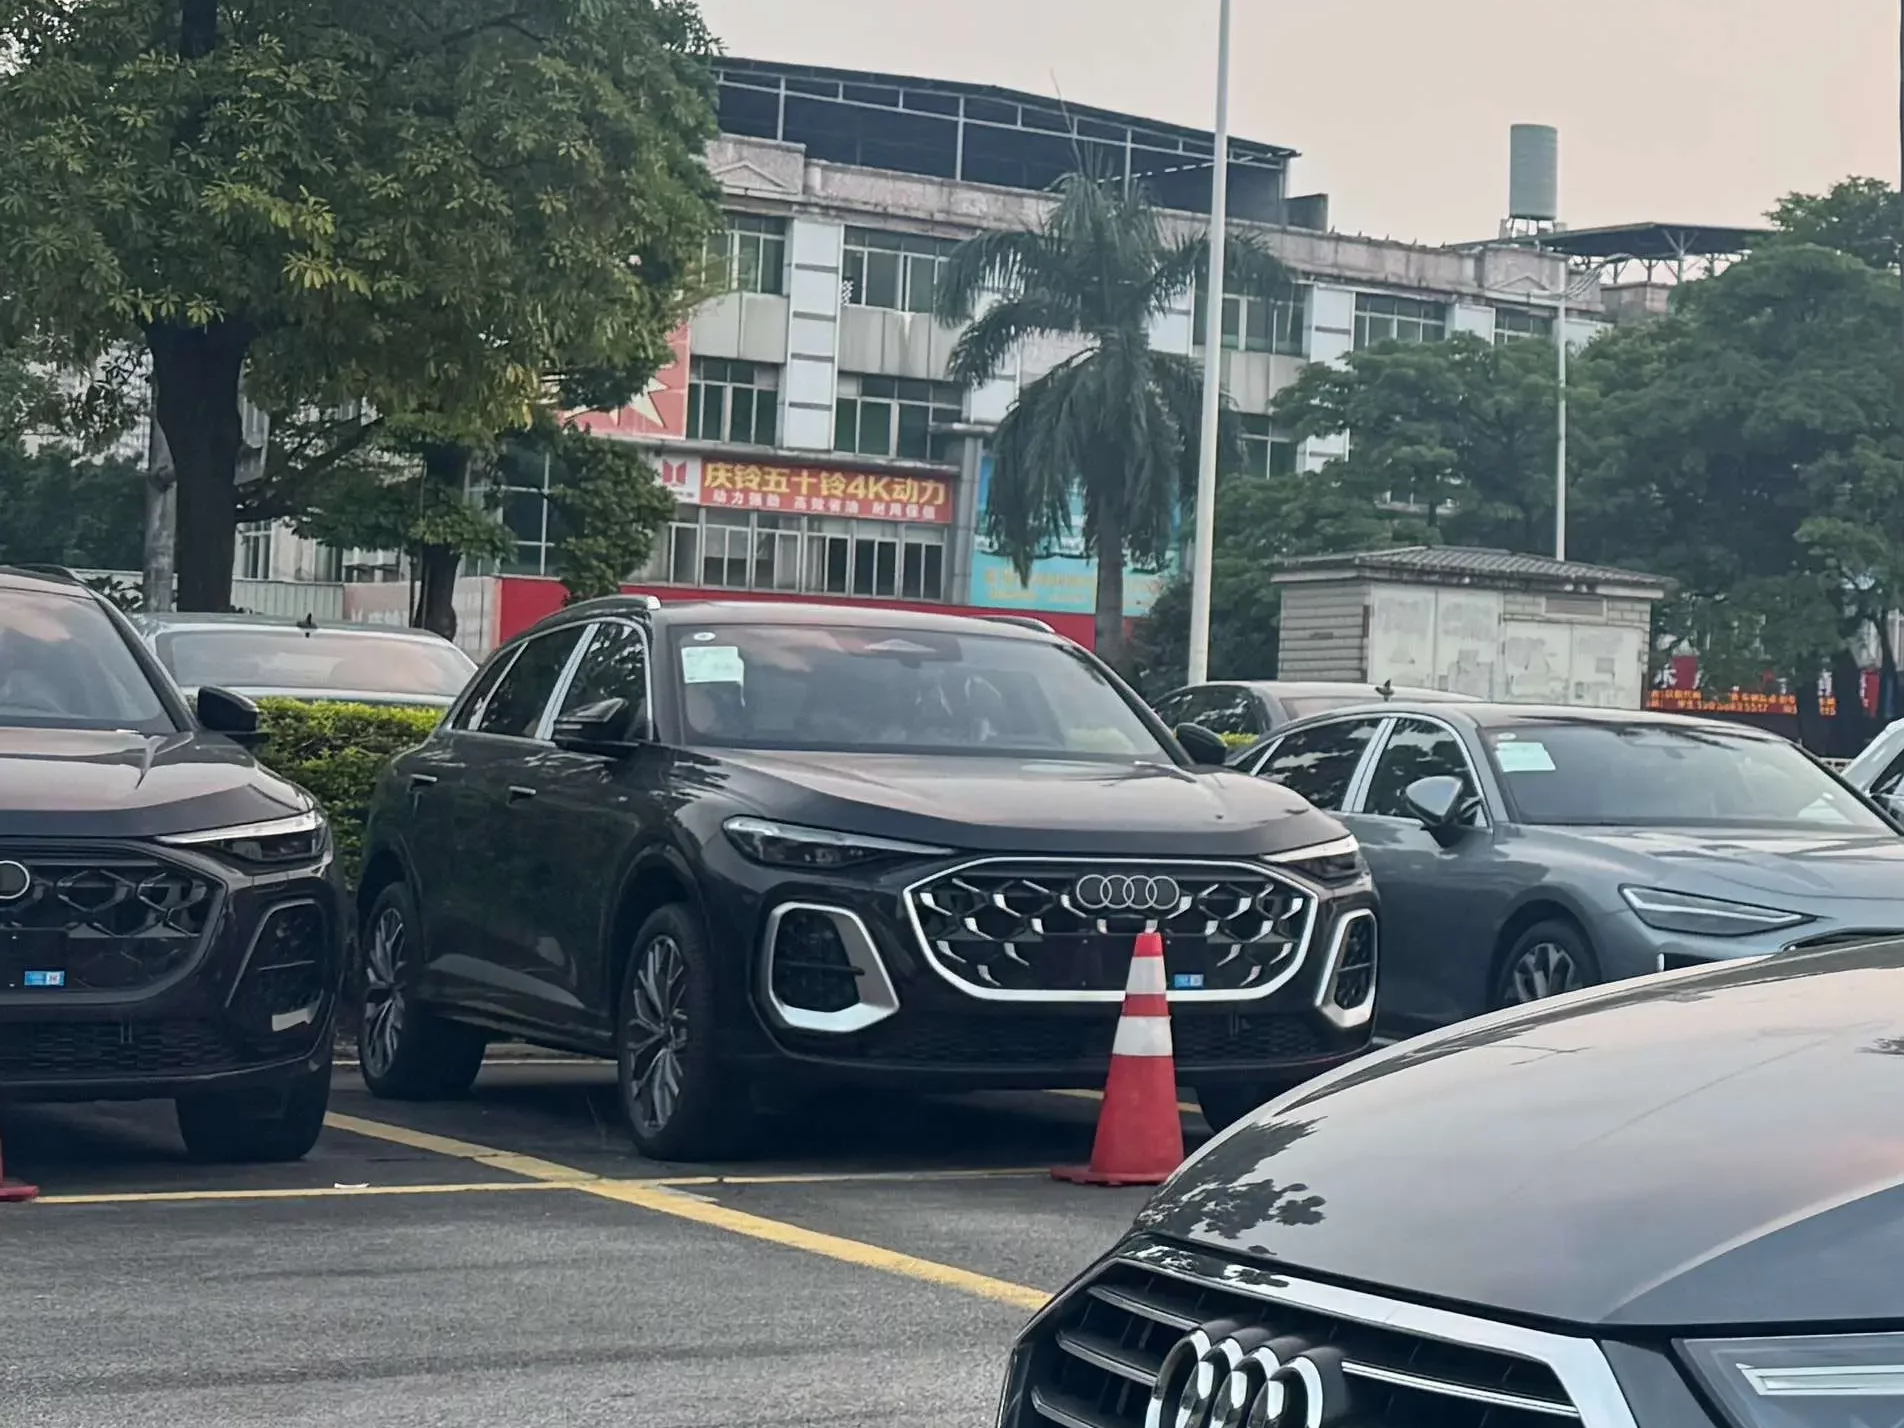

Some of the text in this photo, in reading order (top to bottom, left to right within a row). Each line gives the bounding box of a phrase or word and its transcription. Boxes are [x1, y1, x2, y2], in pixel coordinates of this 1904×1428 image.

[703, 462, 945, 505] 庆铃五十铃4K动力
